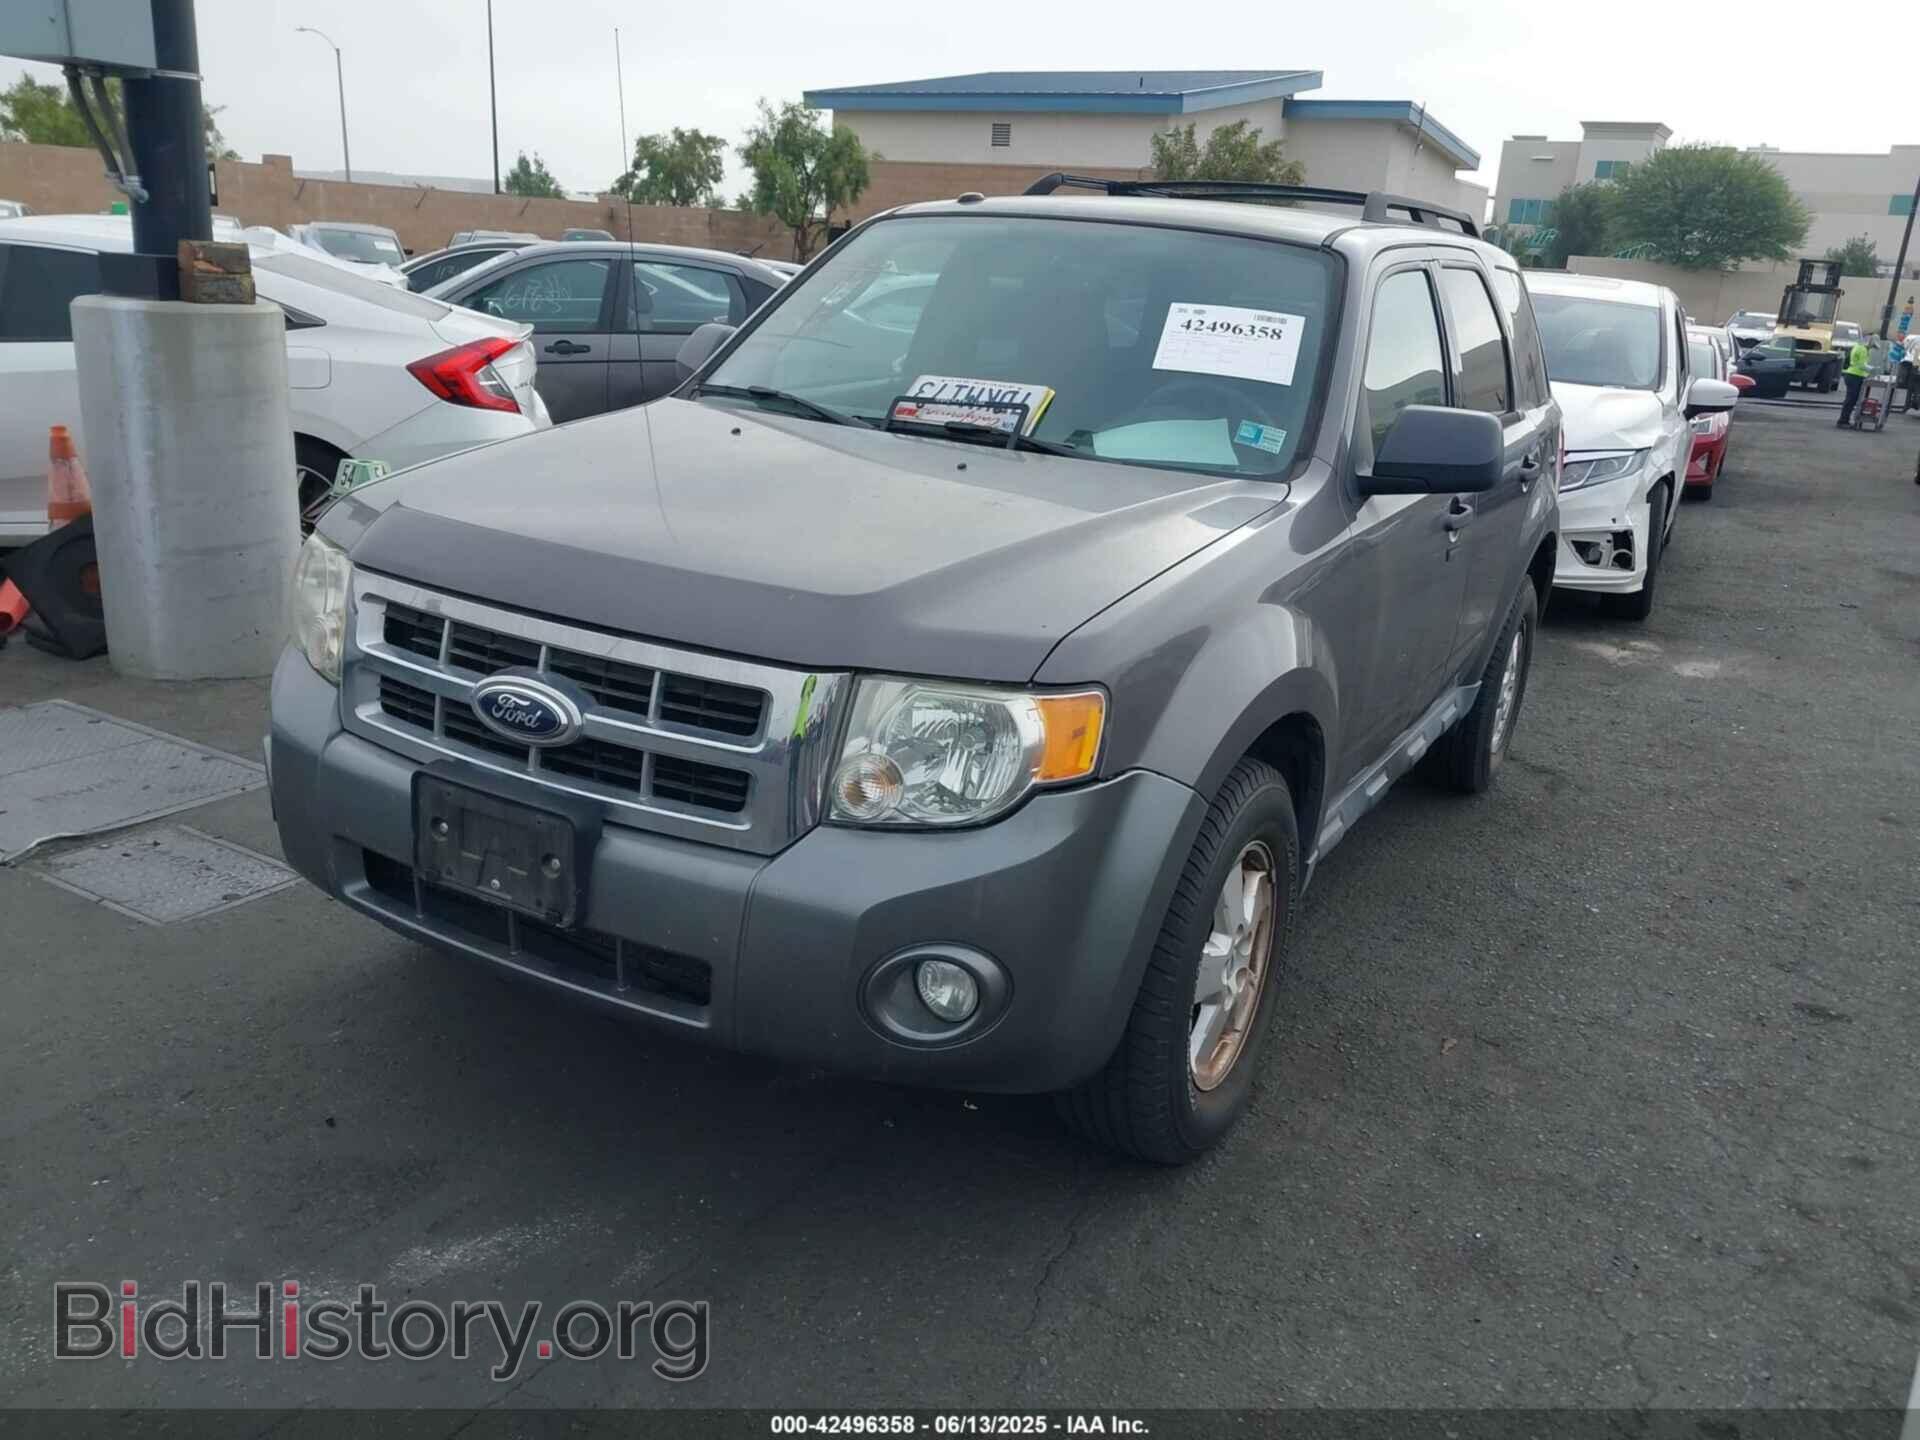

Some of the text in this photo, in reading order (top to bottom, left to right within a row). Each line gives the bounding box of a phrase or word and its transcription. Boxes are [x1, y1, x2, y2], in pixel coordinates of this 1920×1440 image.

[1180, 318, 1284, 341] 42496358
[340, 463, 356, 489] 54
[492, 693, 542, 729] Ford
